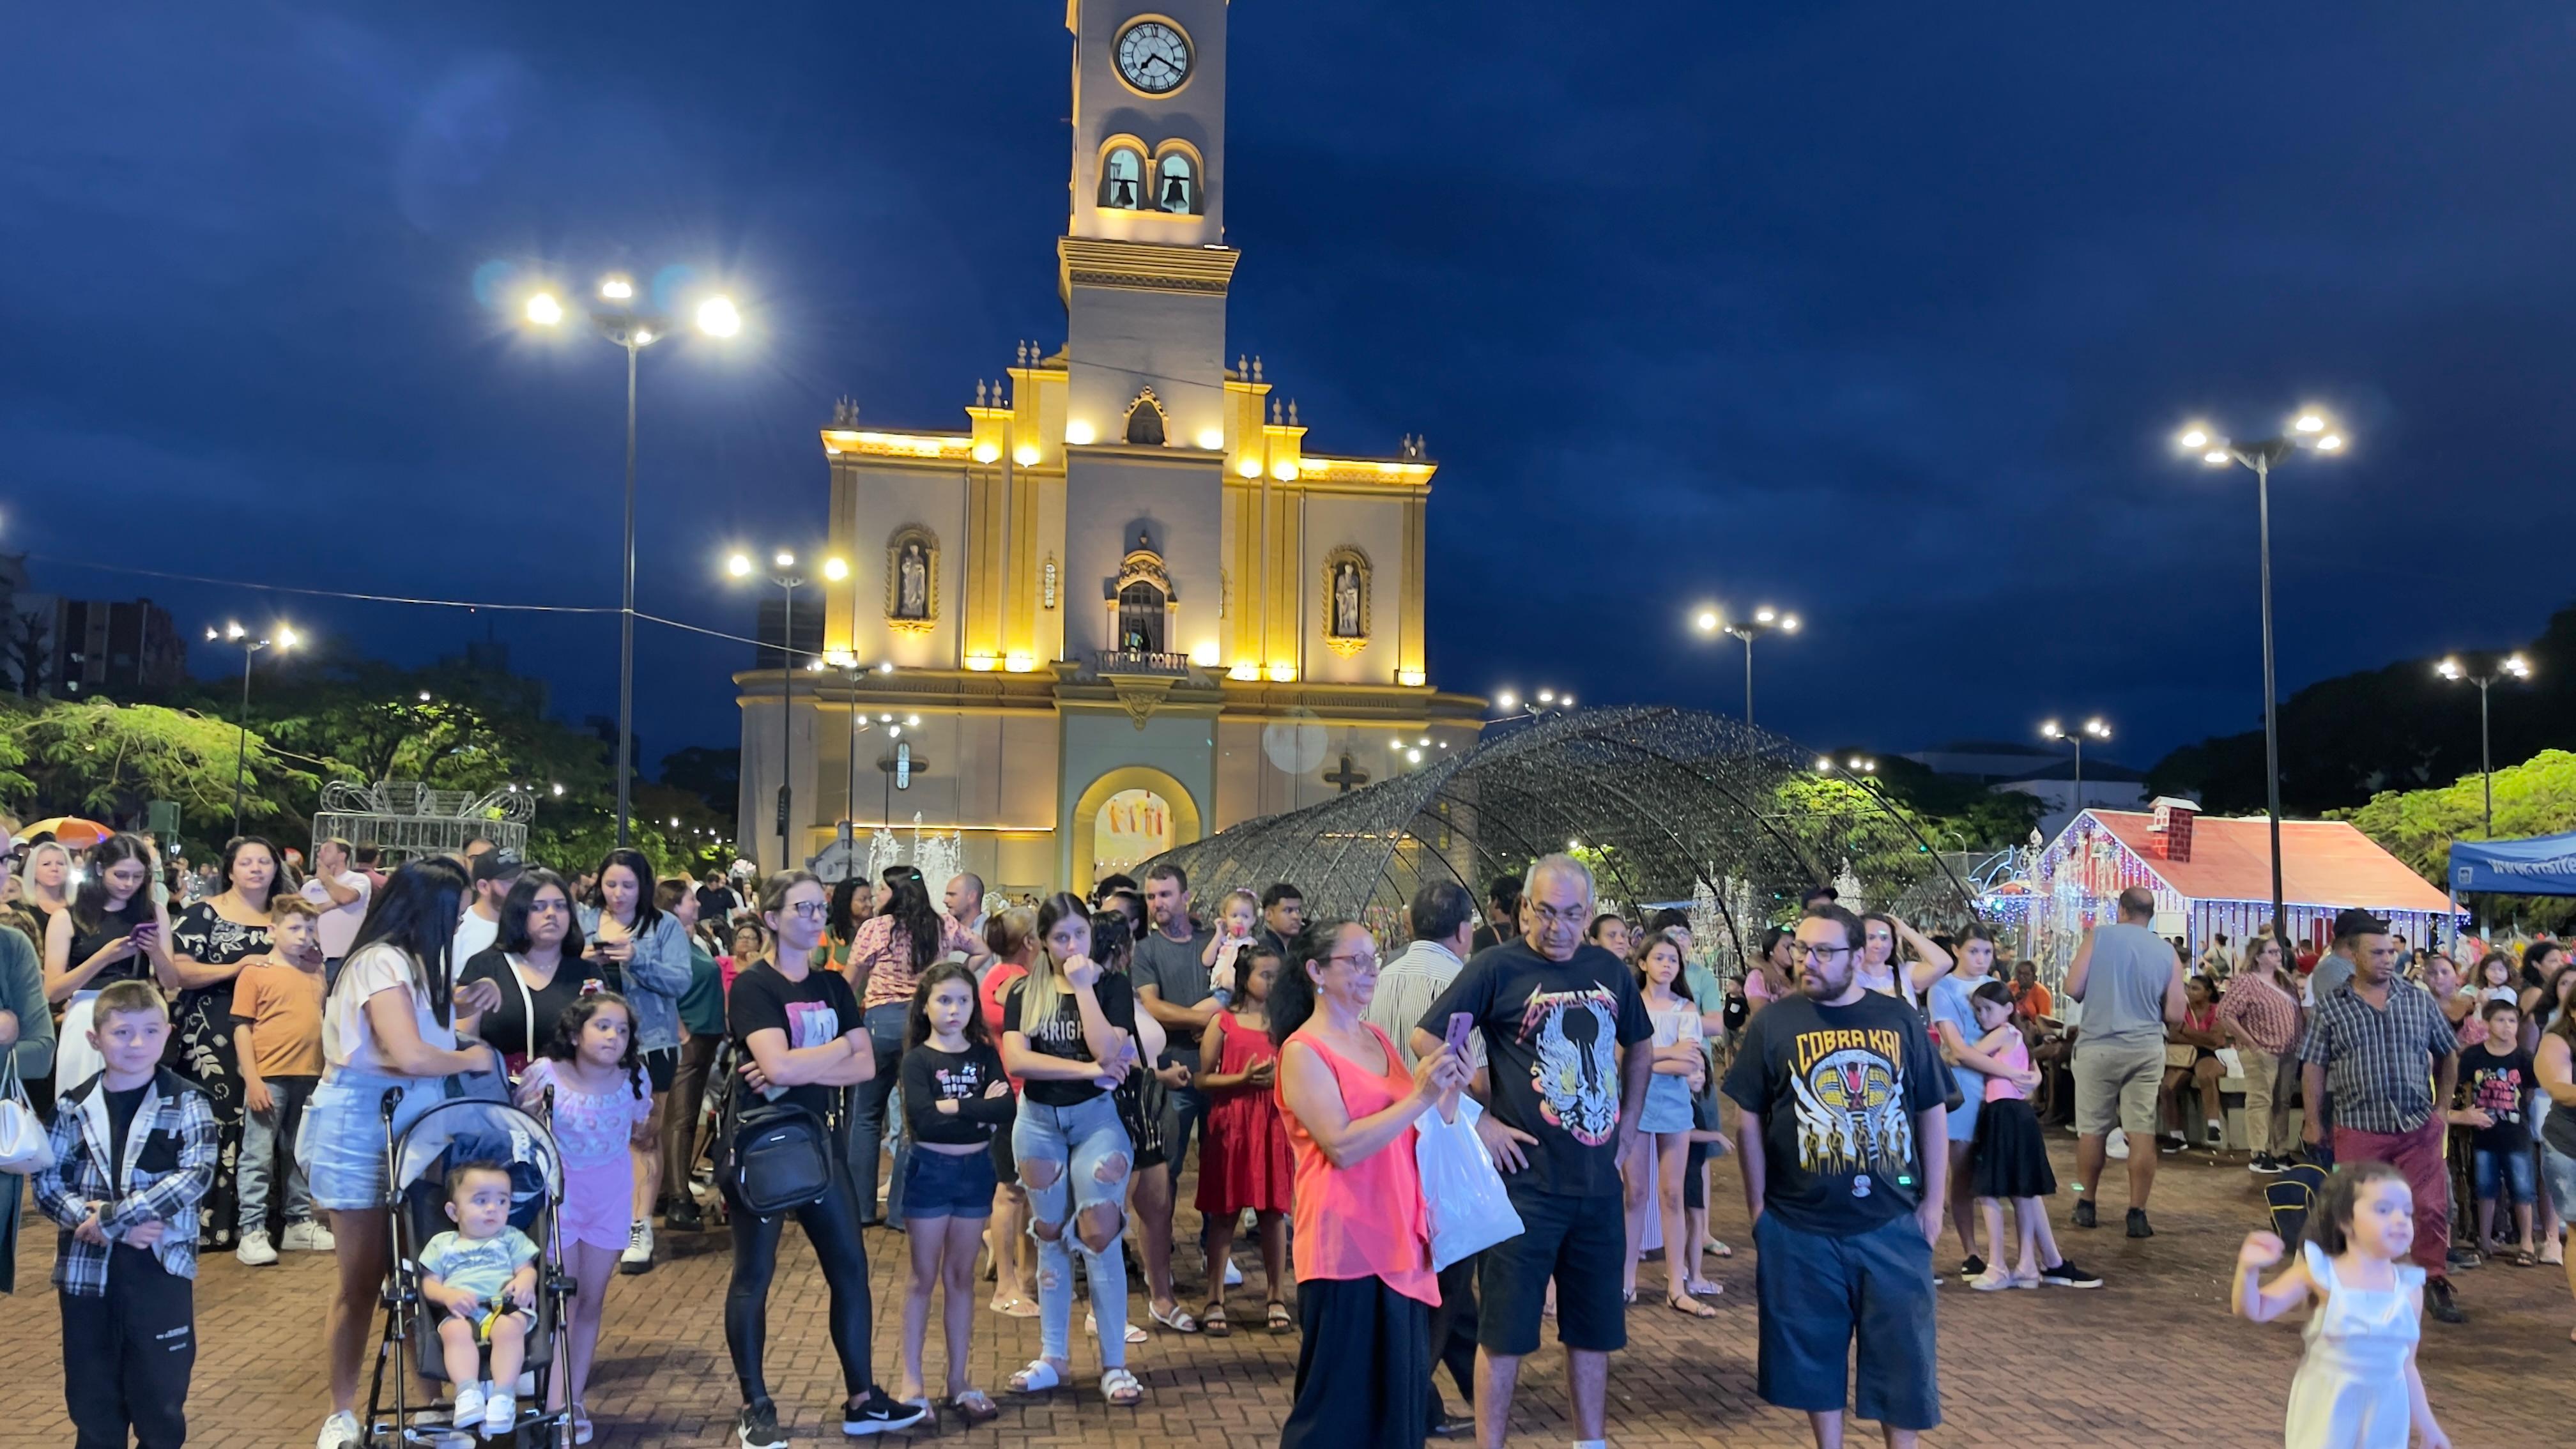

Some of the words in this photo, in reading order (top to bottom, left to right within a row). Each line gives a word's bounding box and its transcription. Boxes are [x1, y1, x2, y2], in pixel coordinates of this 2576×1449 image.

[1515, 979, 1620, 1045] METALLICA
[1795, 1029, 1866, 1077] COBRA
[1867, 1028, 1901, 1073] KAI
